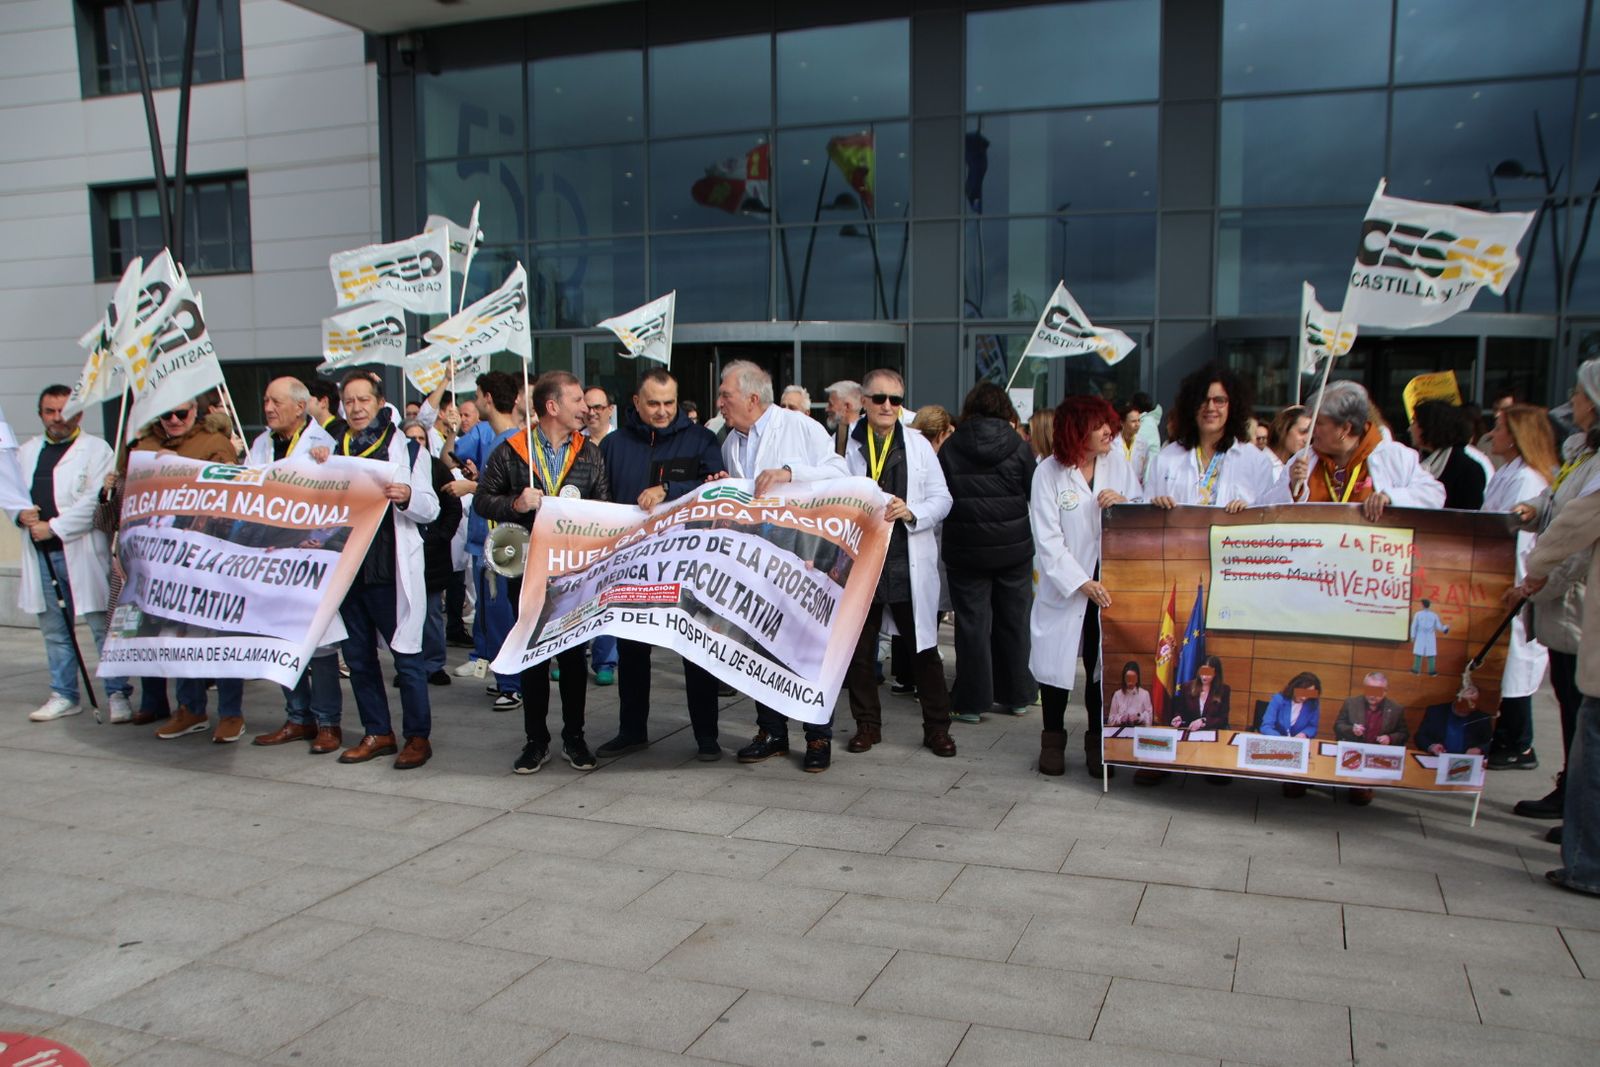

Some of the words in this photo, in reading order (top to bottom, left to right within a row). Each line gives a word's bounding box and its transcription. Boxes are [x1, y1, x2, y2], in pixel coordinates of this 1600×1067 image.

[1351, 272, 1437, 300] CASTILLA
[267, 467, 351, 491] Salamanca
[158, 484, 229, 512] MÉDICA
[231, 491, 350, 526] NACIONAL
[787, 496, 875, 517] Salamanca
[548, 527, 648, 572] HUELGA
[653, 502, 754, 532] MÉDICA
[761, 509, 864, 556] NACIONAL
[173, 541, 202, 569] DE
[195, 548, 223, 573] LA
[217, 554, 329, 591] PROFESIÓN
[587, 561, 610, 581] UN
[612, 534, 701, 567] ESTATUTO
[705, 535, 734, 557] DE
[736, 541, 763, 574] LA
[763, 554, 837, 629] PROFESIÓN
[1372, 559, 1395, 575] DE
[146, 578, 247, 625] FACULTATIVA
[595, 561, 649, 595] MÉDICA
[656, 560, 672, 582] Y
[672, 558, 785, 643] FACULTATIVA
[159, 647, 205, 662] PRIMARIA
[206, 647, 222, 662] DE
[222, 647, 301, 673] SALAMANCA
[620, 611, 661, 627] DEL
[665, 612, 726, 663] HOSPITAL
[728, 649, 749, 672] DE
[745, 659, 825, 708] SALAMANCA
